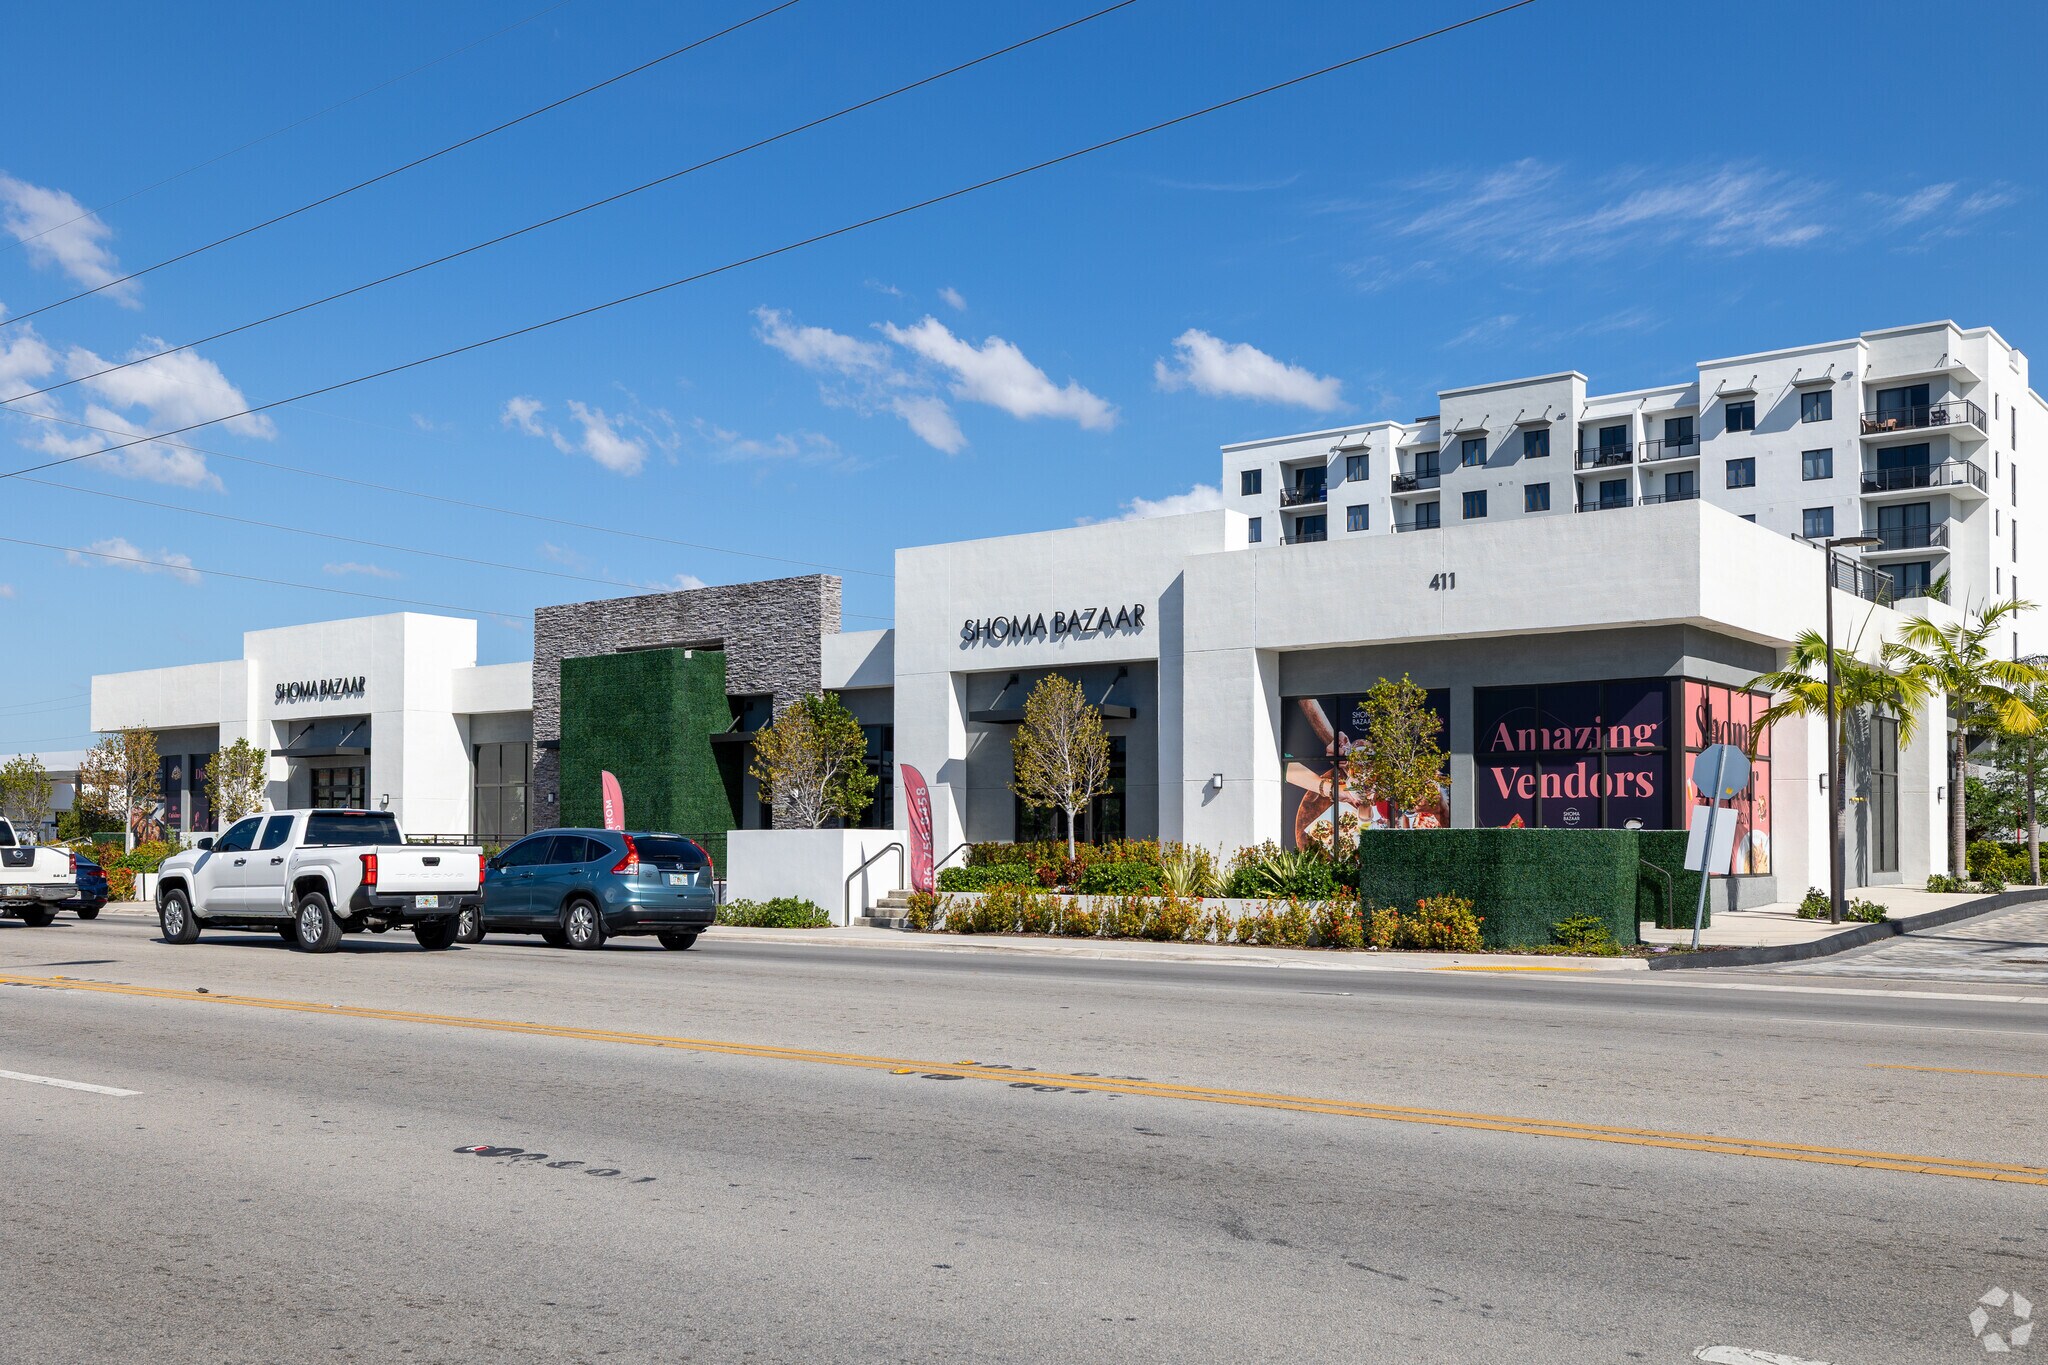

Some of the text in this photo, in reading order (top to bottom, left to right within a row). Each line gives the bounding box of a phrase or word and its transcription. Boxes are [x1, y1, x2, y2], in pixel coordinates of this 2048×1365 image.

[1429, 572, 1456, 591] 411
[964, 603, 1146, 642] SHOMA BAZAAR
[275, 676, 365, 699] SHOMA BAZAAR
[1490, 715, 1658, 756] Amazing
[1696, 703, 1750, 751] Shom
[1490, 761, 1655, 799] Vendors
